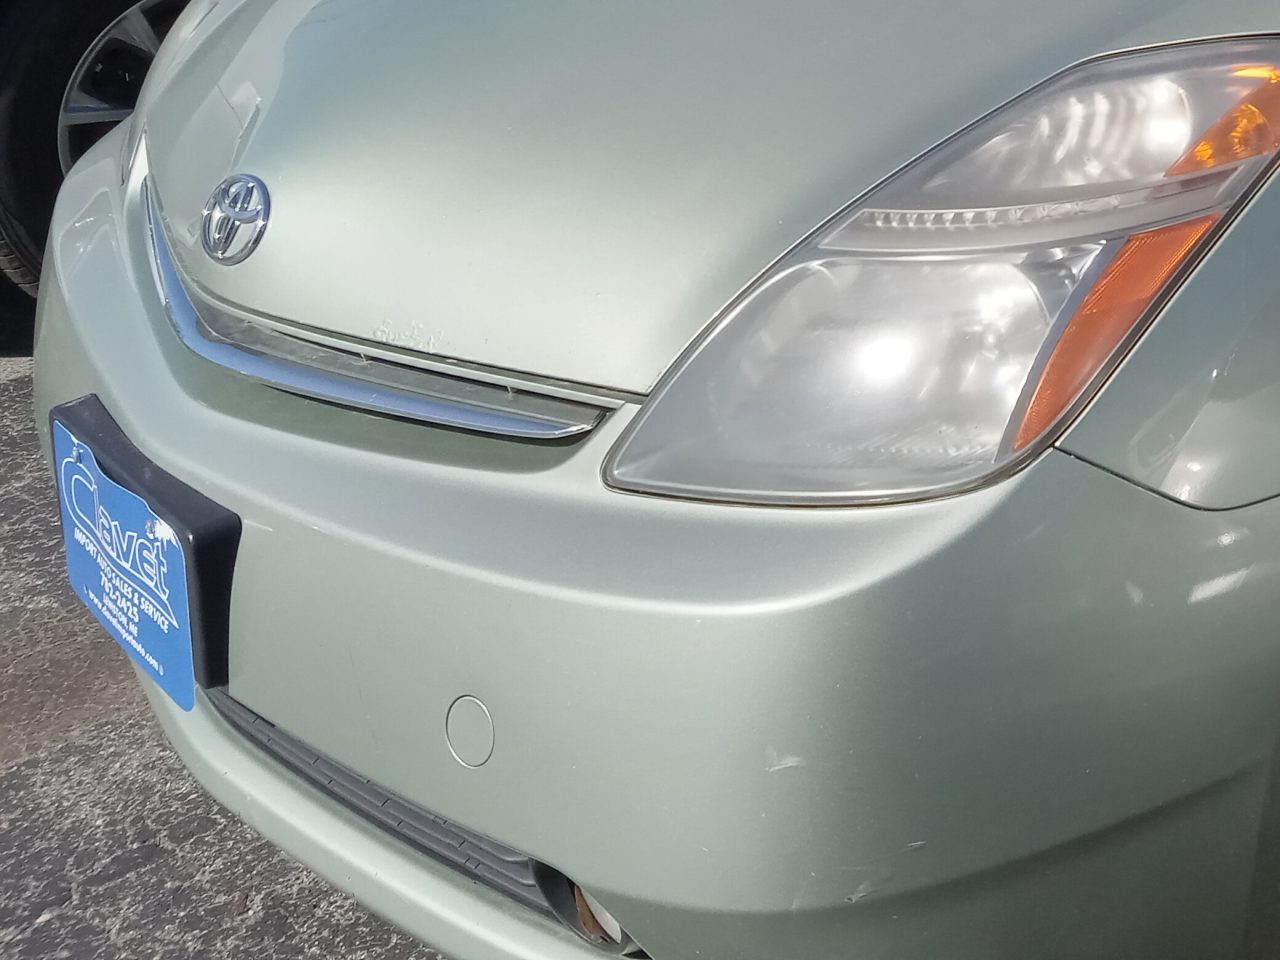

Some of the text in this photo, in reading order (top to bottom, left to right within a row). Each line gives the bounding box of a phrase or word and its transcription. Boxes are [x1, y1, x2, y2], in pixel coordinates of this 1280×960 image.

[62, 458, 171, 603] Clavet
[74, 527, 169, 633] IMPORT AUTO SALES & SERVICE
